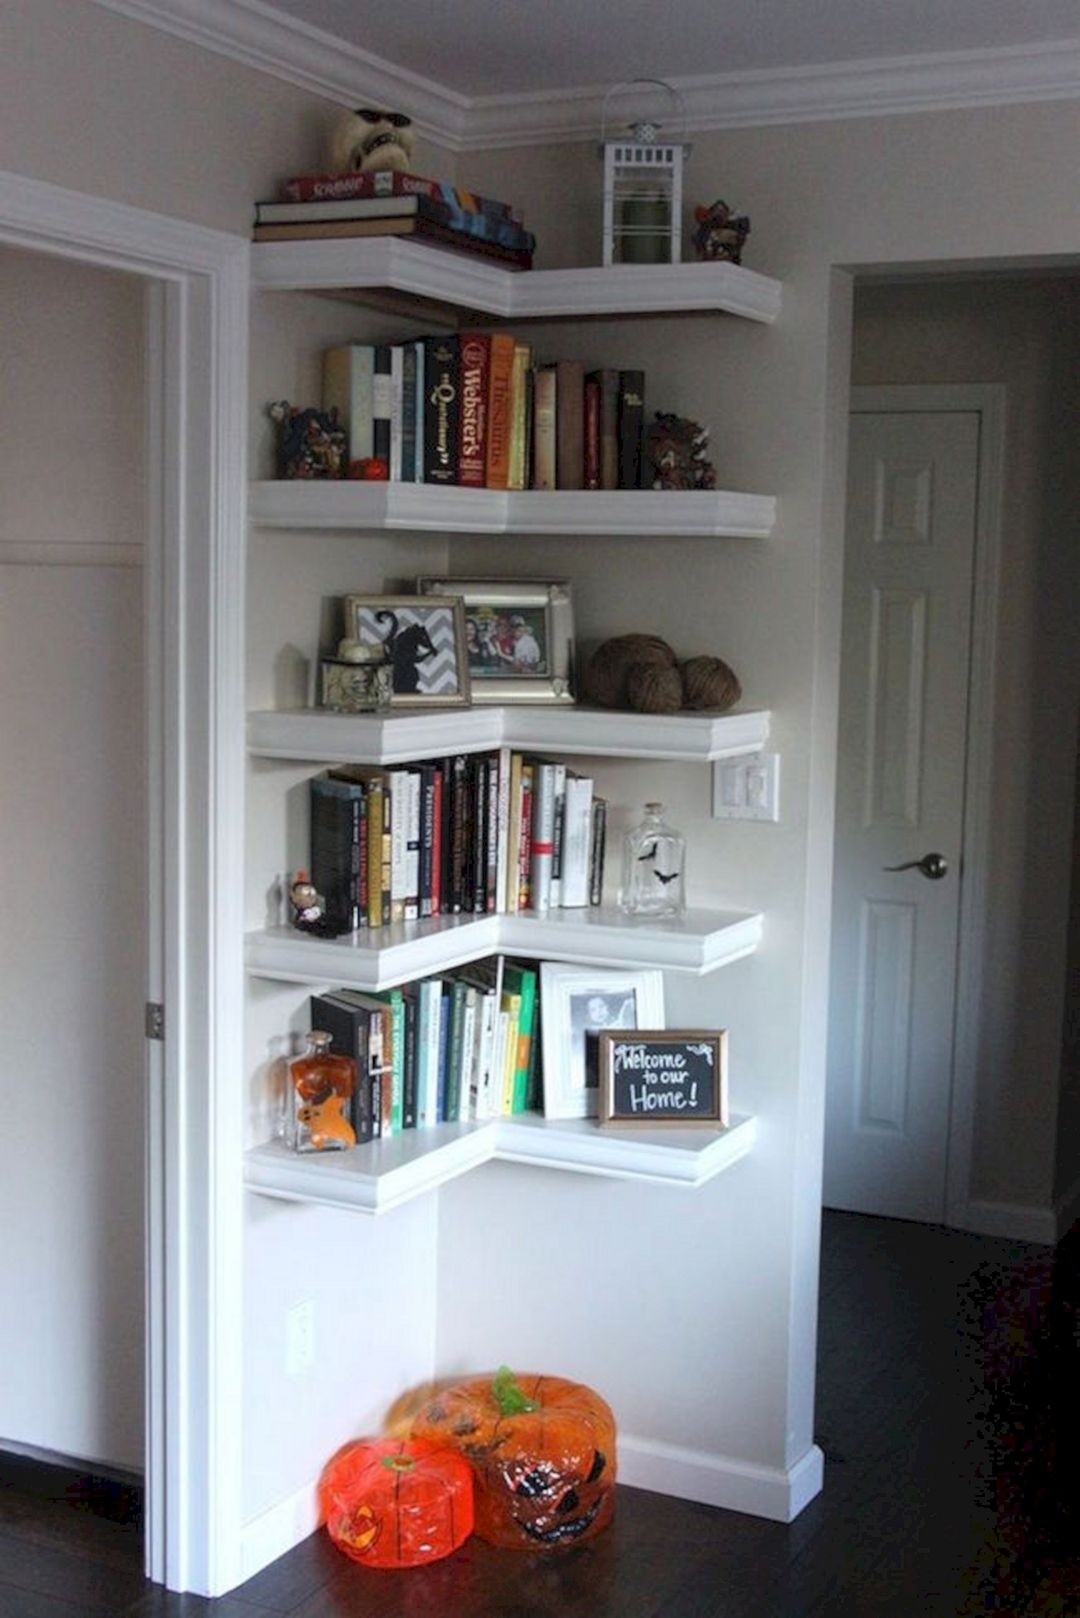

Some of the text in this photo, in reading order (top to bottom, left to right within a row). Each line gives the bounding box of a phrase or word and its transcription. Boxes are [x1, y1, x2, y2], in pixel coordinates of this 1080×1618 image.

[462, 368, 482, 456] Webster's
[491, 374, 509, 466] Thesaurus
[621, 1045, 686, 1070] Welcome
[642, 1070, 689, 1084] to our
[630, 1082, 698, 1112] Home!
